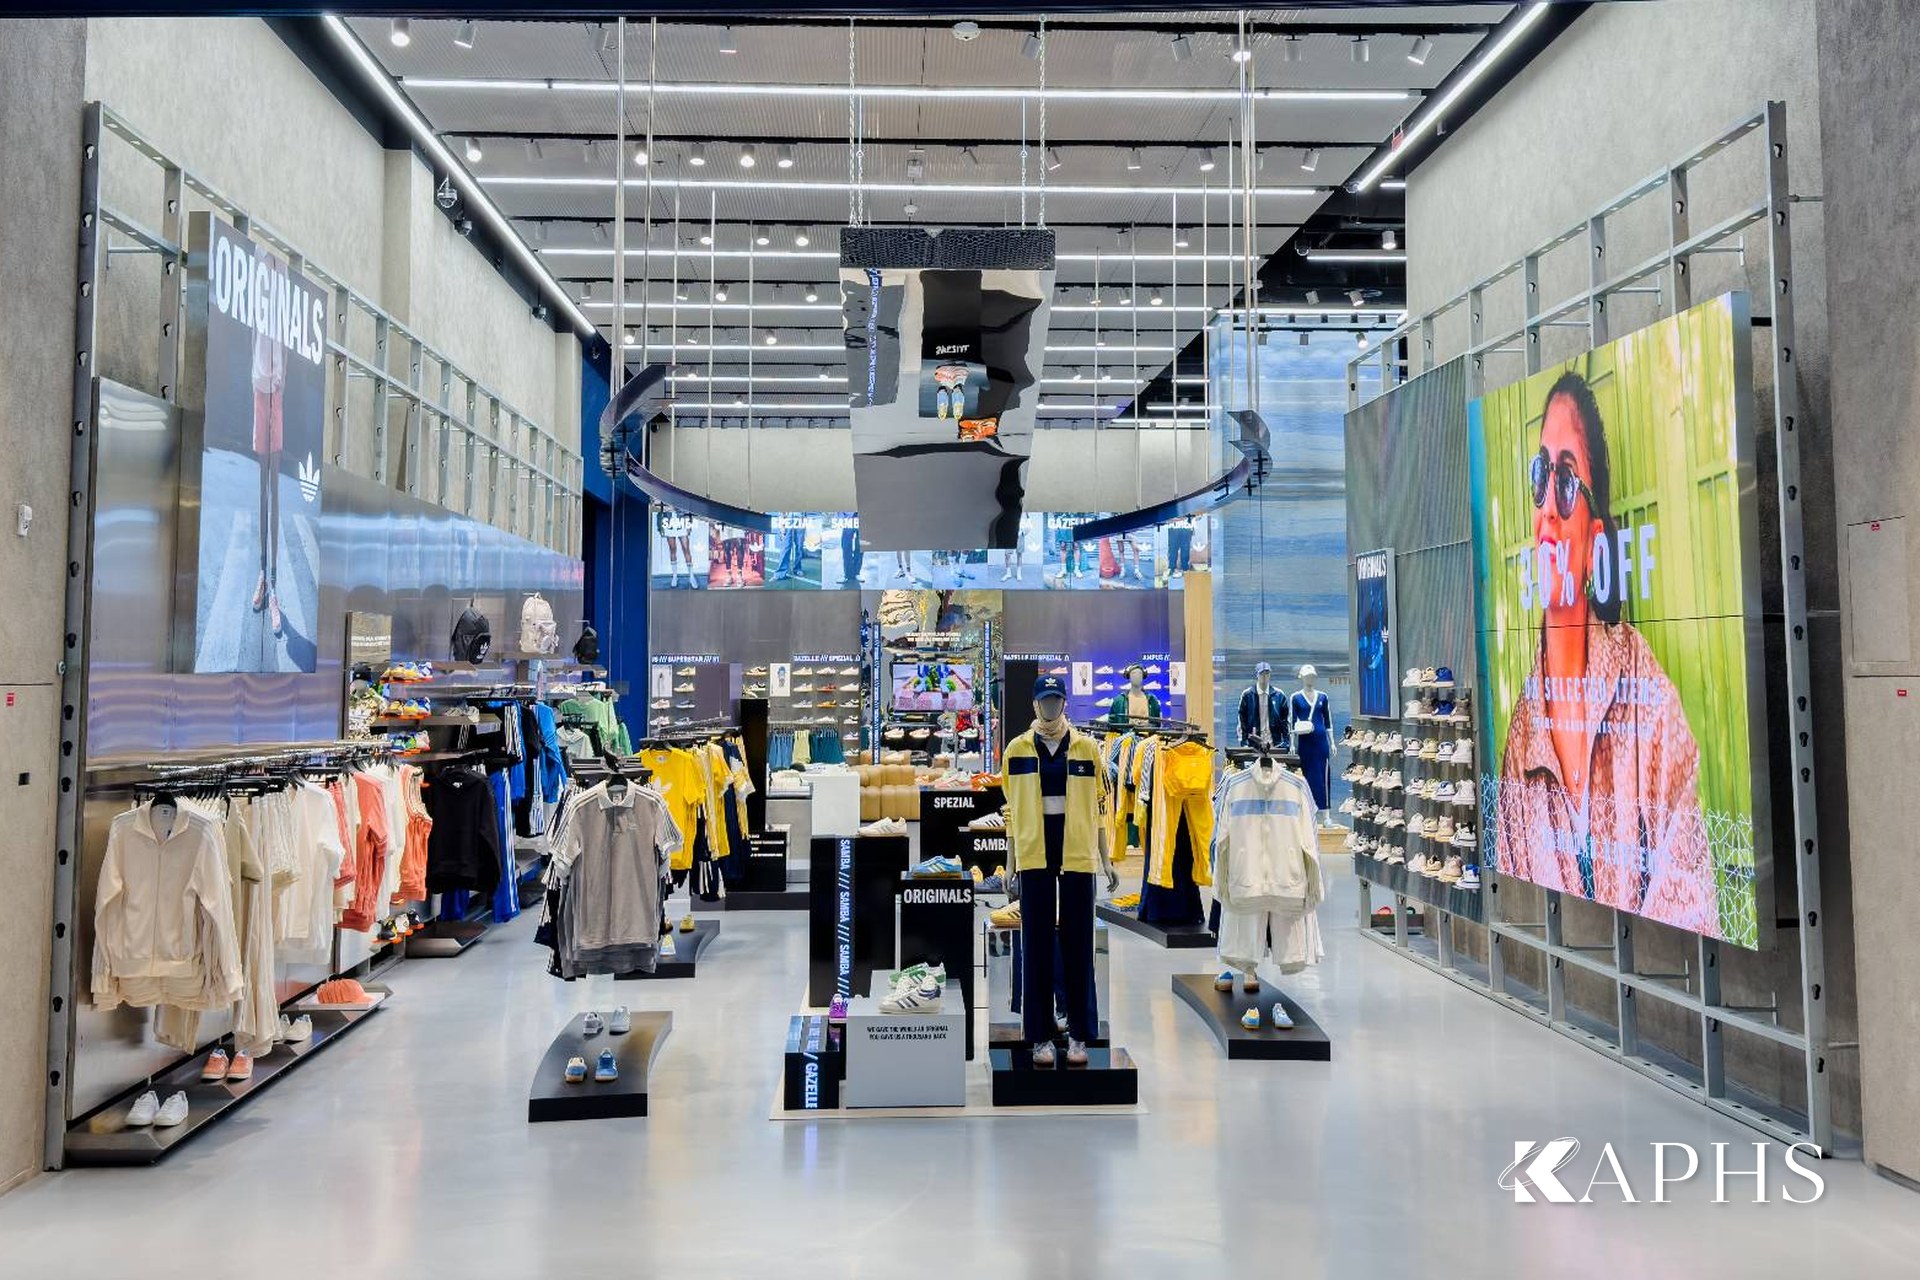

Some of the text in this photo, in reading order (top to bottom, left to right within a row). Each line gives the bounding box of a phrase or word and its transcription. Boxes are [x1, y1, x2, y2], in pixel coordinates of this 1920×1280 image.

[215, 236, 324, 365] ORIGINALS
[831, 517, 860, 529] SAMB
[1519, 524, 1656, 611] 30% OFF
[1544, 676, 1608, 704] SELECTED
[934, 796, 975, 809] SPEZIAL
[840, 839, 850, 870] SAMBA
[840, 891, 850, 923] SAMBA
[903, 888, 972, 904] ORIGINALS
[839, 944, 850, 976] SAMBA
[805, 1062, 819, 1109] GAZELLE
